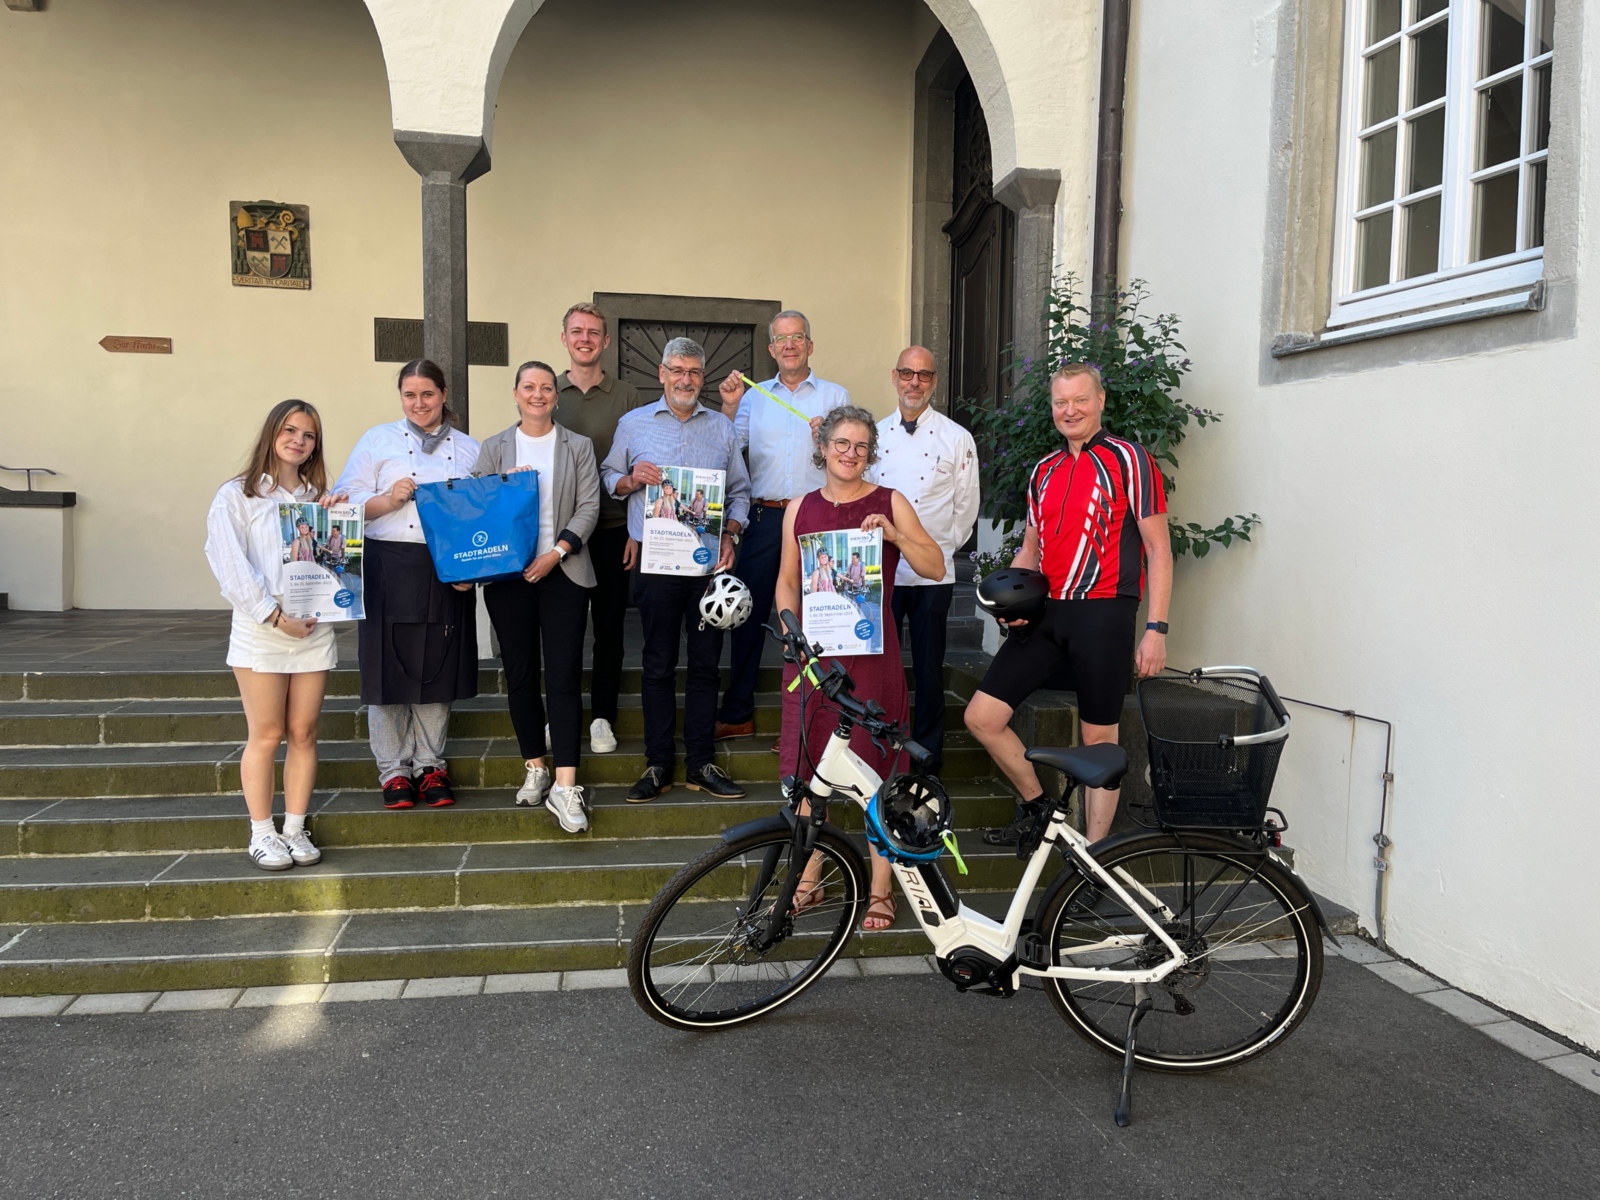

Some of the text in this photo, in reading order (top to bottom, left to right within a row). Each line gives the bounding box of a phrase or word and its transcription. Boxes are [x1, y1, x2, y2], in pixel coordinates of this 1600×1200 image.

[468, 324, 502, 334] ICHAEL
[113, 338, 130, 350] Zur
[650, 529, 692, 537] STADTRADELN
[453, 544, 508, 560] STADTRADELN
